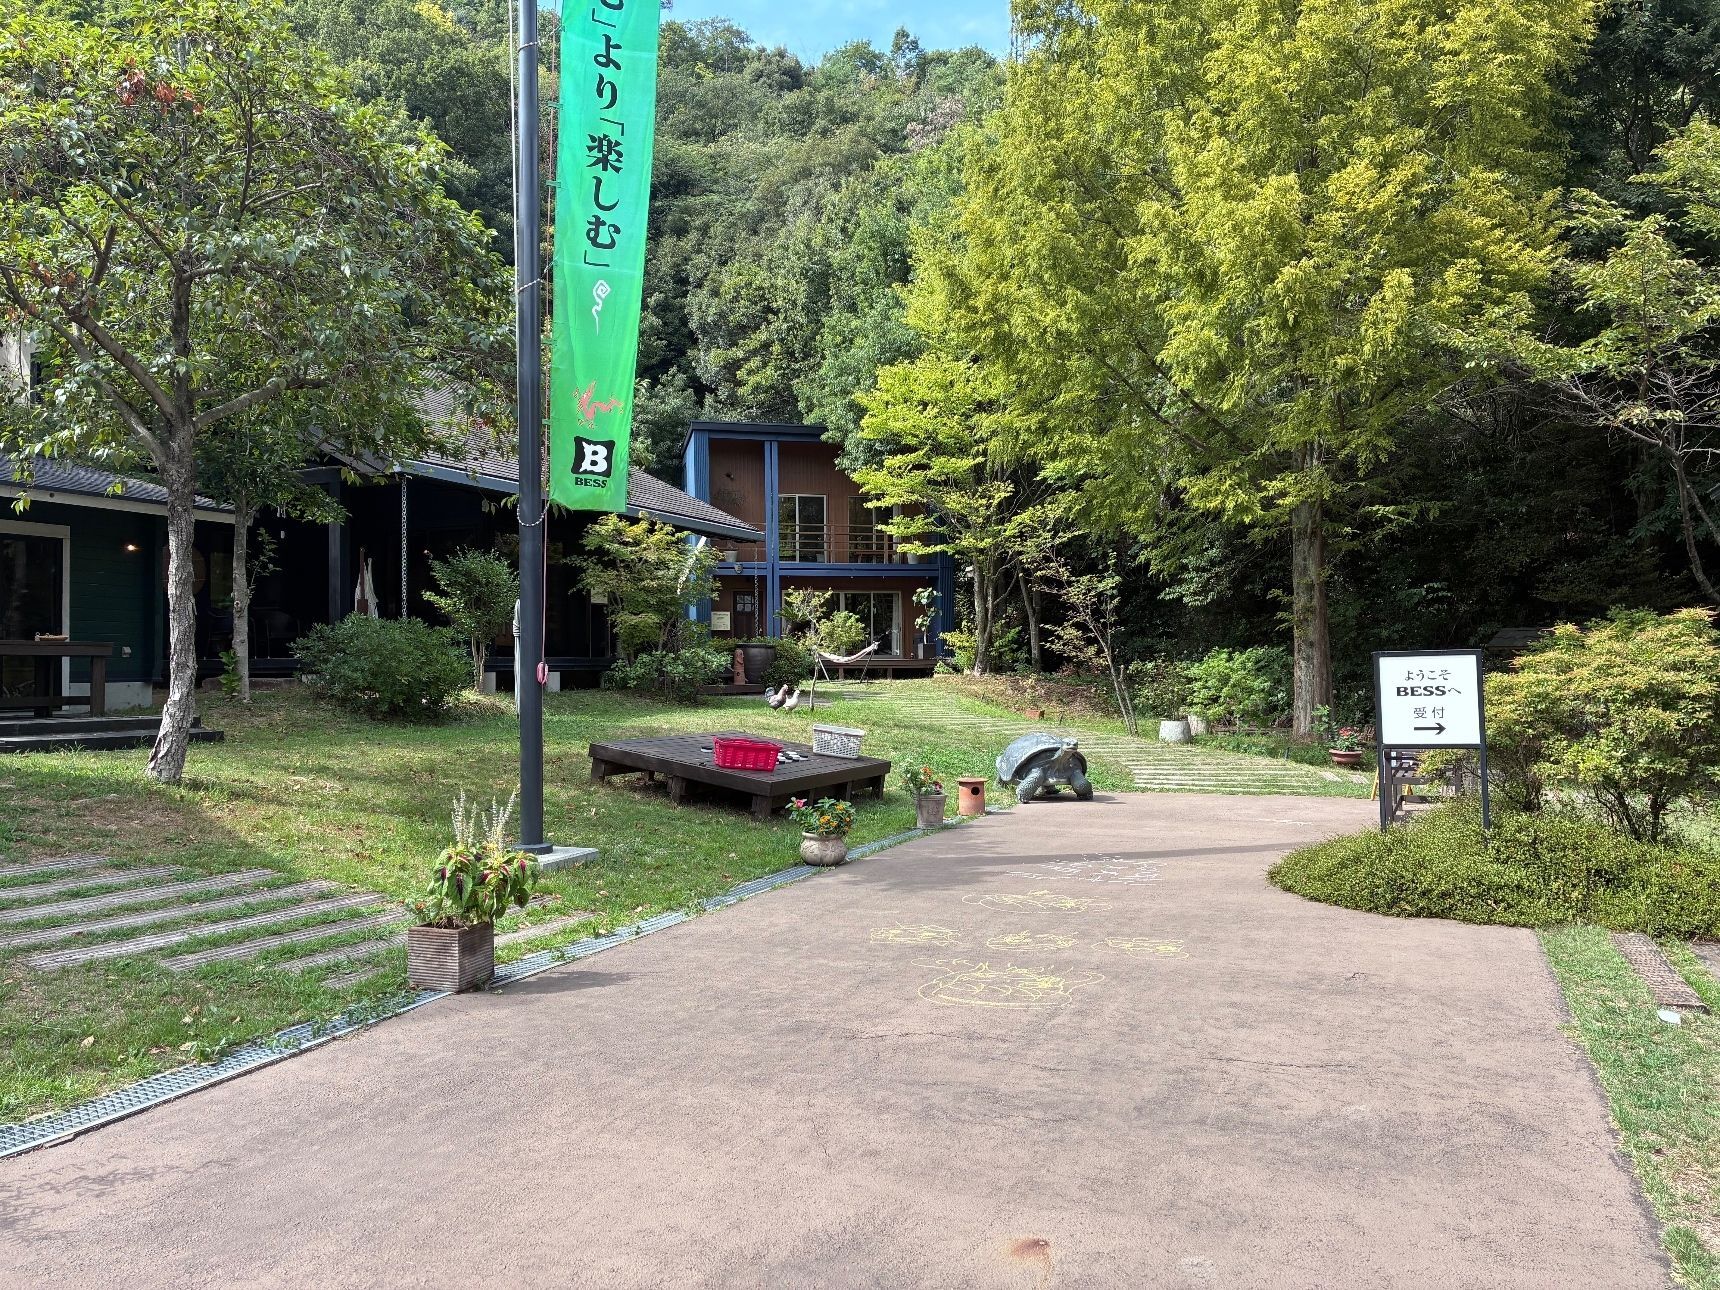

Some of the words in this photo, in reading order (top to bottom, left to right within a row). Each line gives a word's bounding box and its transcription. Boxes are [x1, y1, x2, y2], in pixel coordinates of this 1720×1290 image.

[579, 441, 608, 473] B
[574, 477, 607, 488] BESS
[1405, 669, 1451, 681] ようこそ
[1396, 686, 1461, 697] BESSへ
[1413, 706, 1445, 719] 受付
